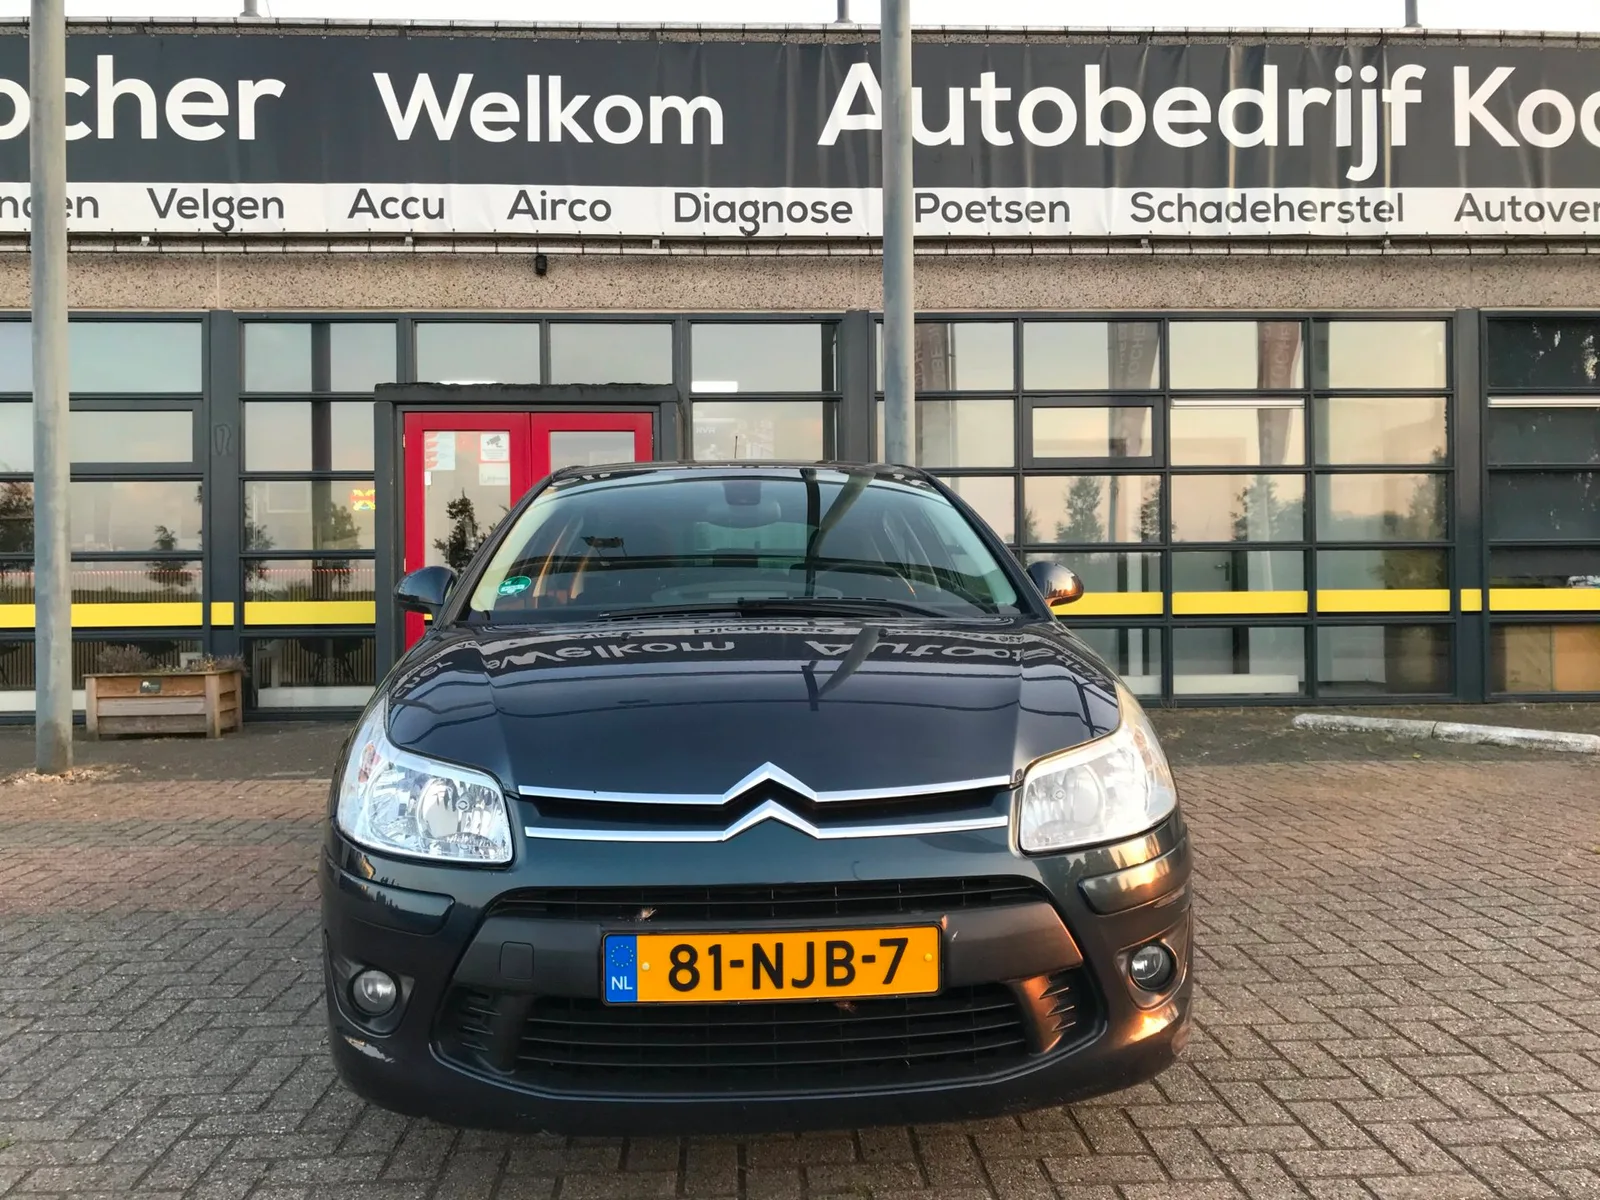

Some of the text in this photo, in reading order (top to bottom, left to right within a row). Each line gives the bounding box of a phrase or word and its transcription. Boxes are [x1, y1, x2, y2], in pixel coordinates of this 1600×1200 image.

[373, 73, 723, 144] Welkom
[818, 63, 1426, 182] Autobedrijf
[147, 188, 283, 233] Velgen
[348, 189, 443, 220] Accu
[507, 190, 611, 222] Airco
[675, 193, 852, 236] Diagnose
[915, 193, 1070, 223] Poetsen
[1131, 192, 1402, 223] Schadeherstel
[611, 976, 632, 990] NL
[669, 938, 908, 992] 81-NJB-7
